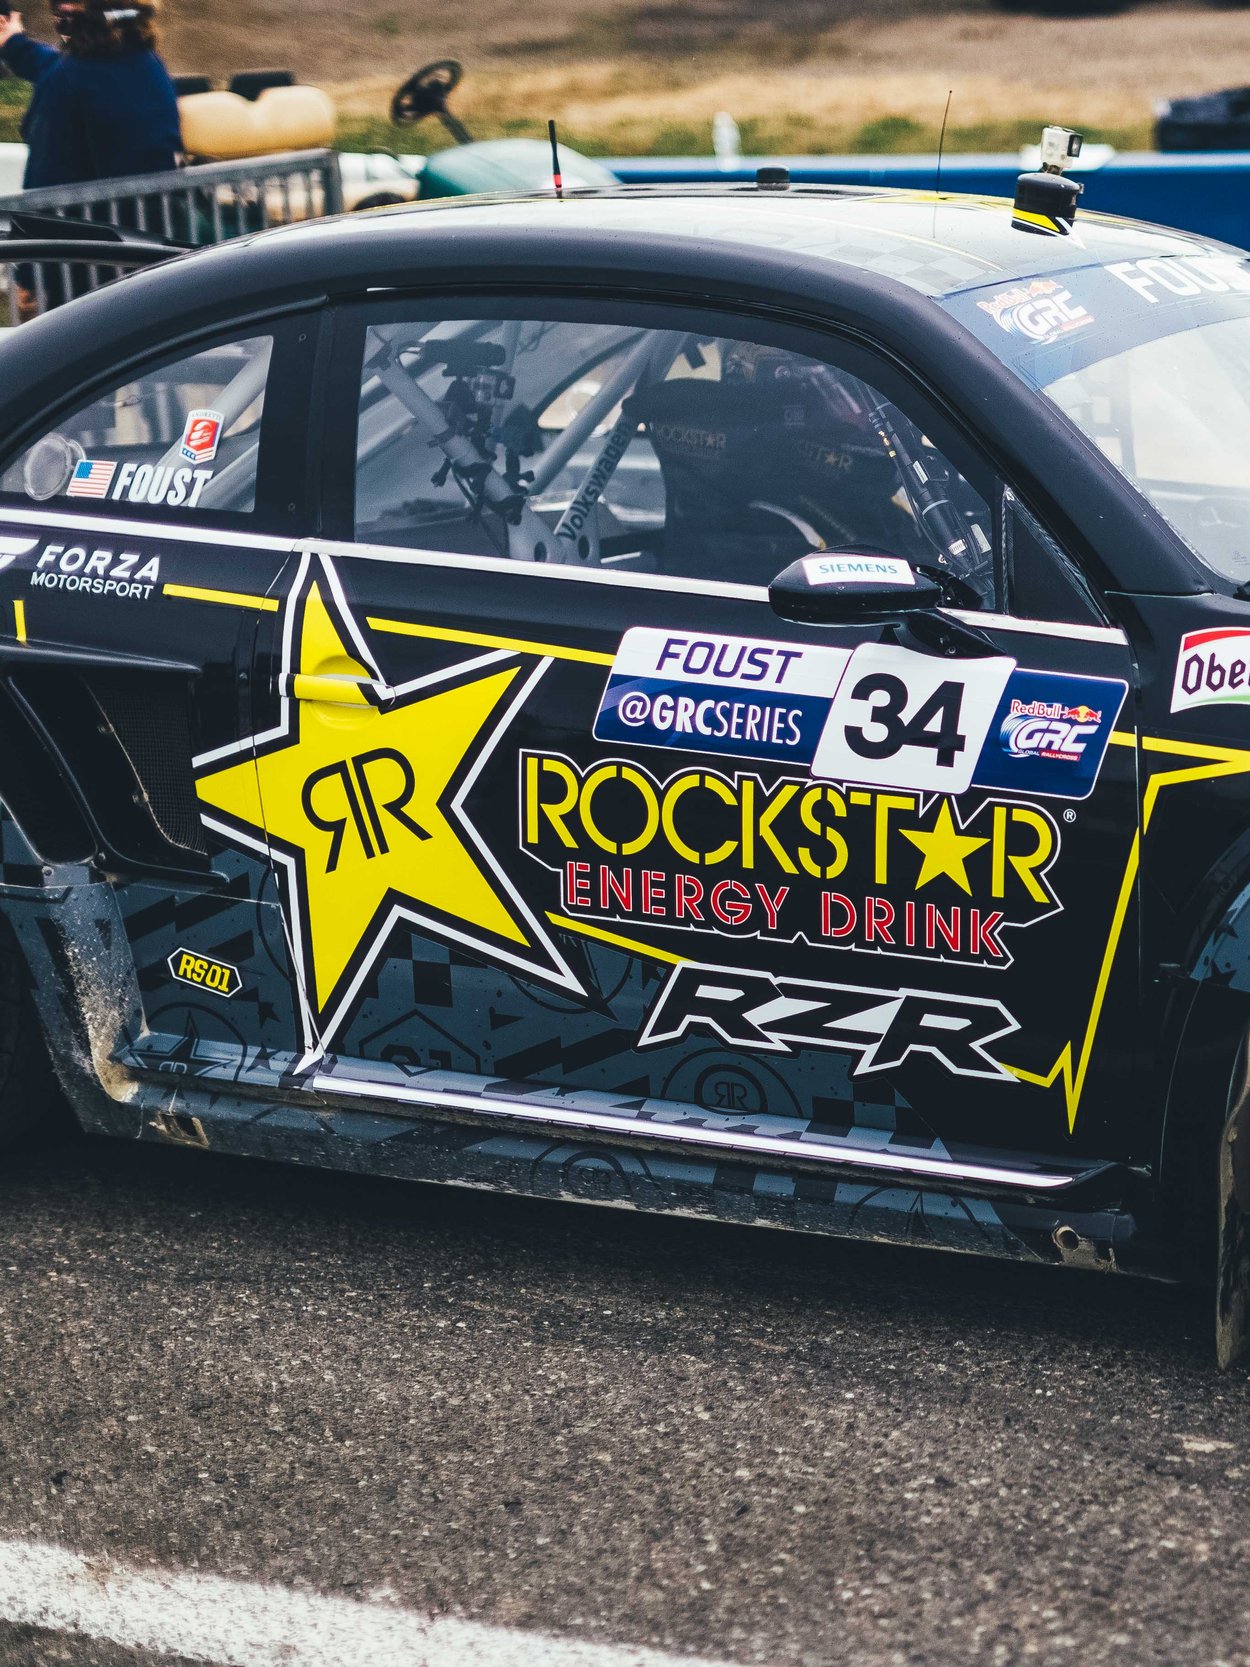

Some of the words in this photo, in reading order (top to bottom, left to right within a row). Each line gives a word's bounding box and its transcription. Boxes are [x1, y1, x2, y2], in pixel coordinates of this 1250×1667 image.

[111, 463, 213, 507] FOUST
[558, 422, 632, 541] Volkswagen
[30, 571, 153, 599] MOTORSPORT
[36, 545, 160, 581] FORZA
[818, 563, 898, 574] SIEMENS
[655, 638, 803, 684] FOUST
[617, 690, 803, 746] @GRCSERIES
[843, 672, 967, 767] 34
[1015, 720, 1099, 753] GRC
[1017, 749, 1040, 757] GLOBAL
[1041, 751, 1079, 762] RALLYCROSS
[567, 860, 790, 931] ENERGY
[821, 890, 1005, 958] DRINK
[178, 953, 231, 993] RS01
[637, 960, 1022, 1083] RZR
